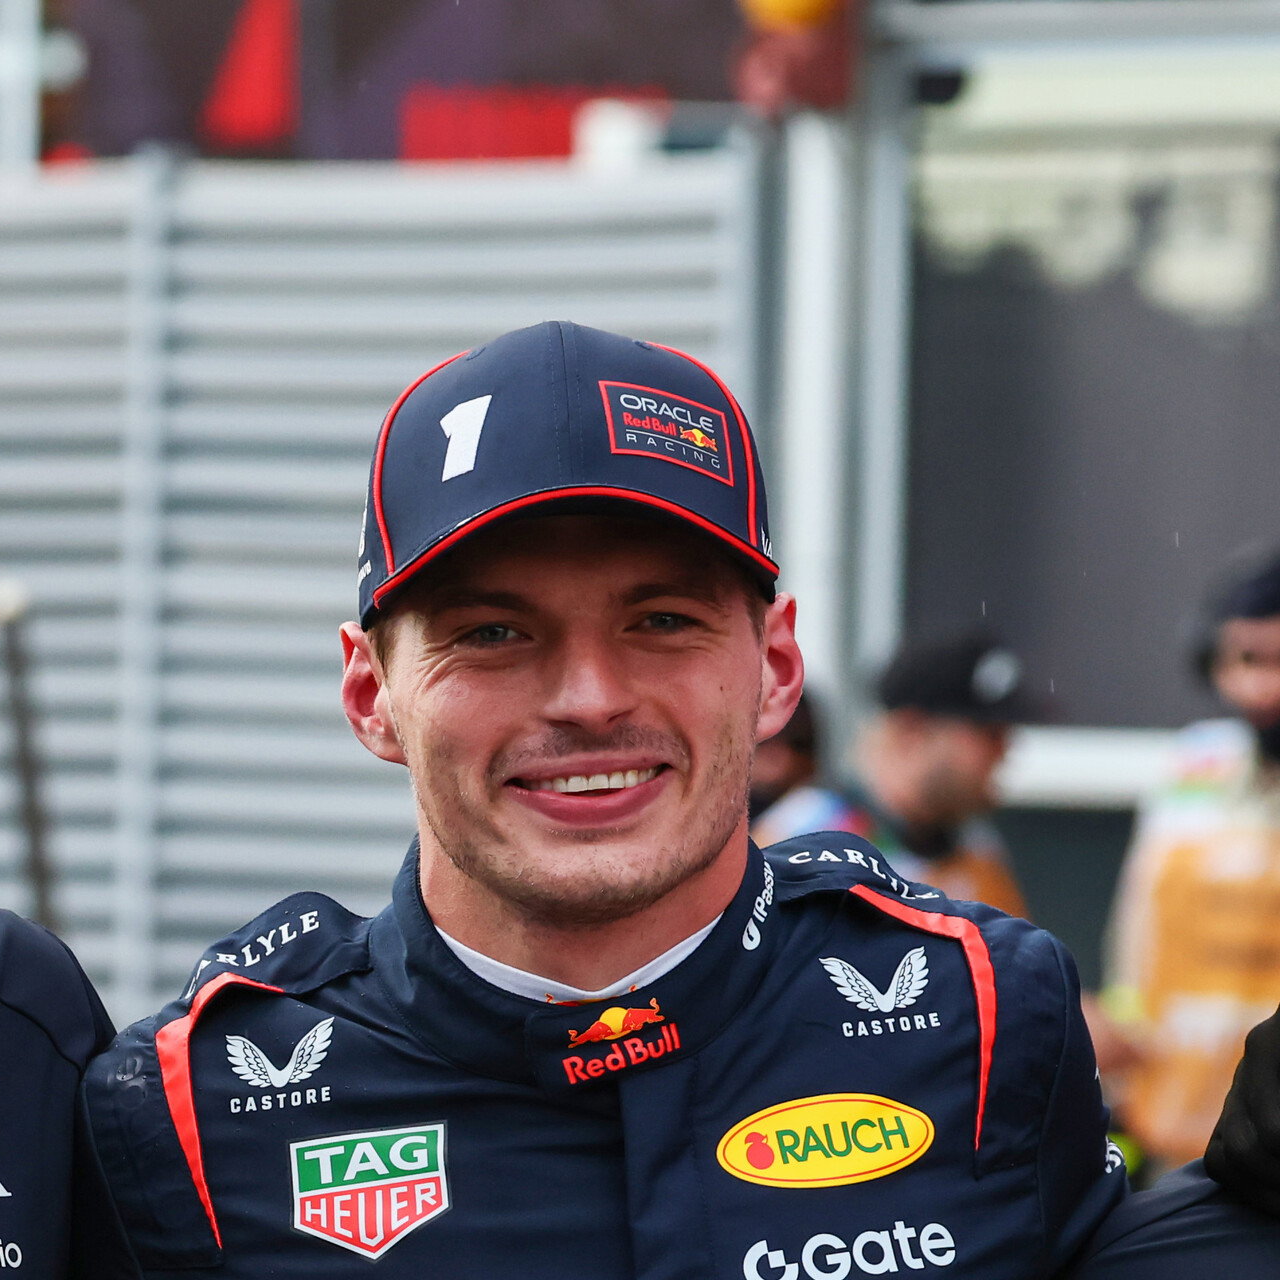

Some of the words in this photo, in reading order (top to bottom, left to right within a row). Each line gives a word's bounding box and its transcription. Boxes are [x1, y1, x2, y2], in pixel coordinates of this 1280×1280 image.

[620, 394, 715, 434] ORACLE
[622, 411, 651, 430] Red
[651, 417, 677, 437] Bull
[439, 394, 493, 483] 1
[626, 433, 721, 469] RACING
[842, 1012, 941, 1038] CASTORE
[562, 1043, 627, 1084] Red
[623, 1022, 681, 1065] Bull
[230, 1086, 332, 1114] CASTORE
[304, 1136, 429, 1185] TAG
[775, 1115, 910, 1165] RAUCH
[305, 1182, 437, 1247] HEUER
